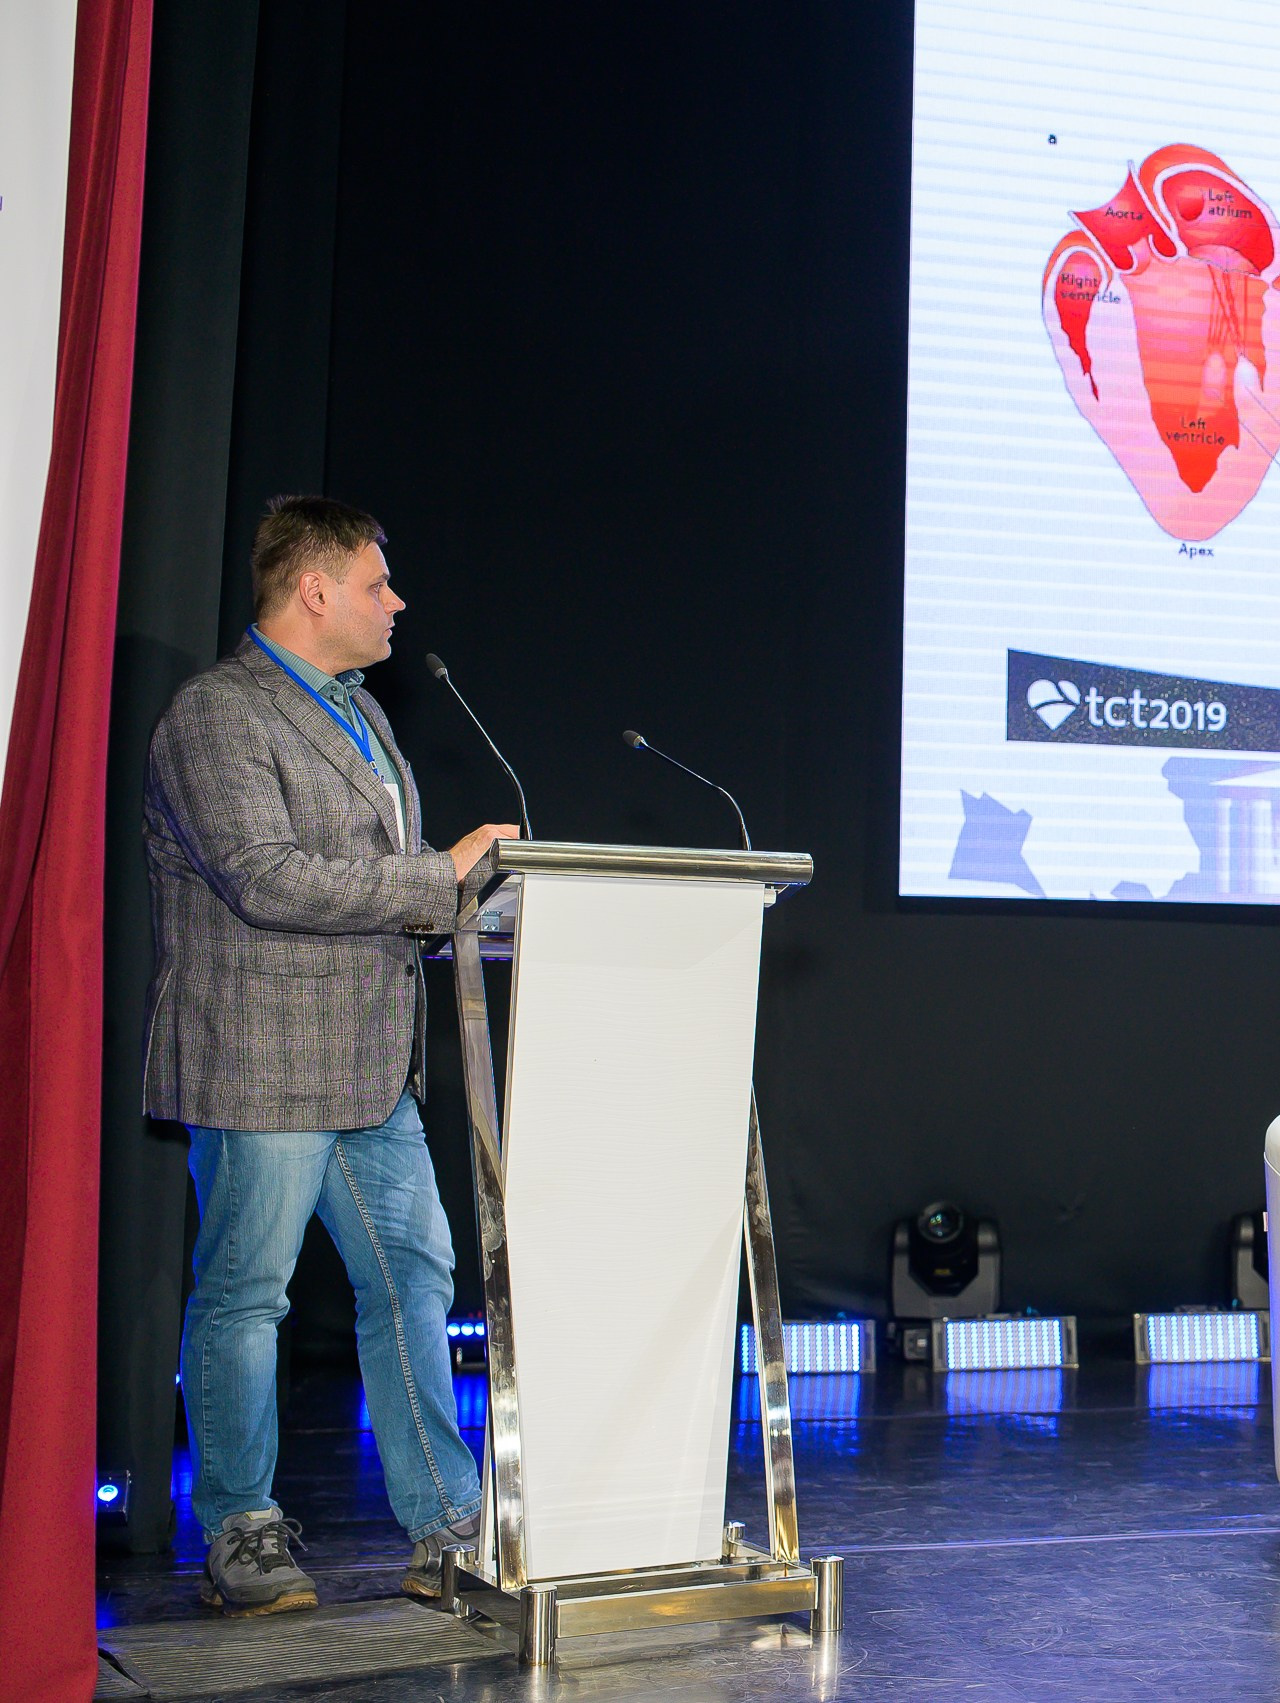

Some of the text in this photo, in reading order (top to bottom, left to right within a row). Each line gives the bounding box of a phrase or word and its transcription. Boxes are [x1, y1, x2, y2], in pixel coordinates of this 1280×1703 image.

[1048, 134, 1058, 145] a
[1180, 416, 1206, 430] Left
[1165, 430, 1225, 446] ventricle
[1178, 542, 1215, 558] Apex
[1085, 686, 1228, 732] tct2019
